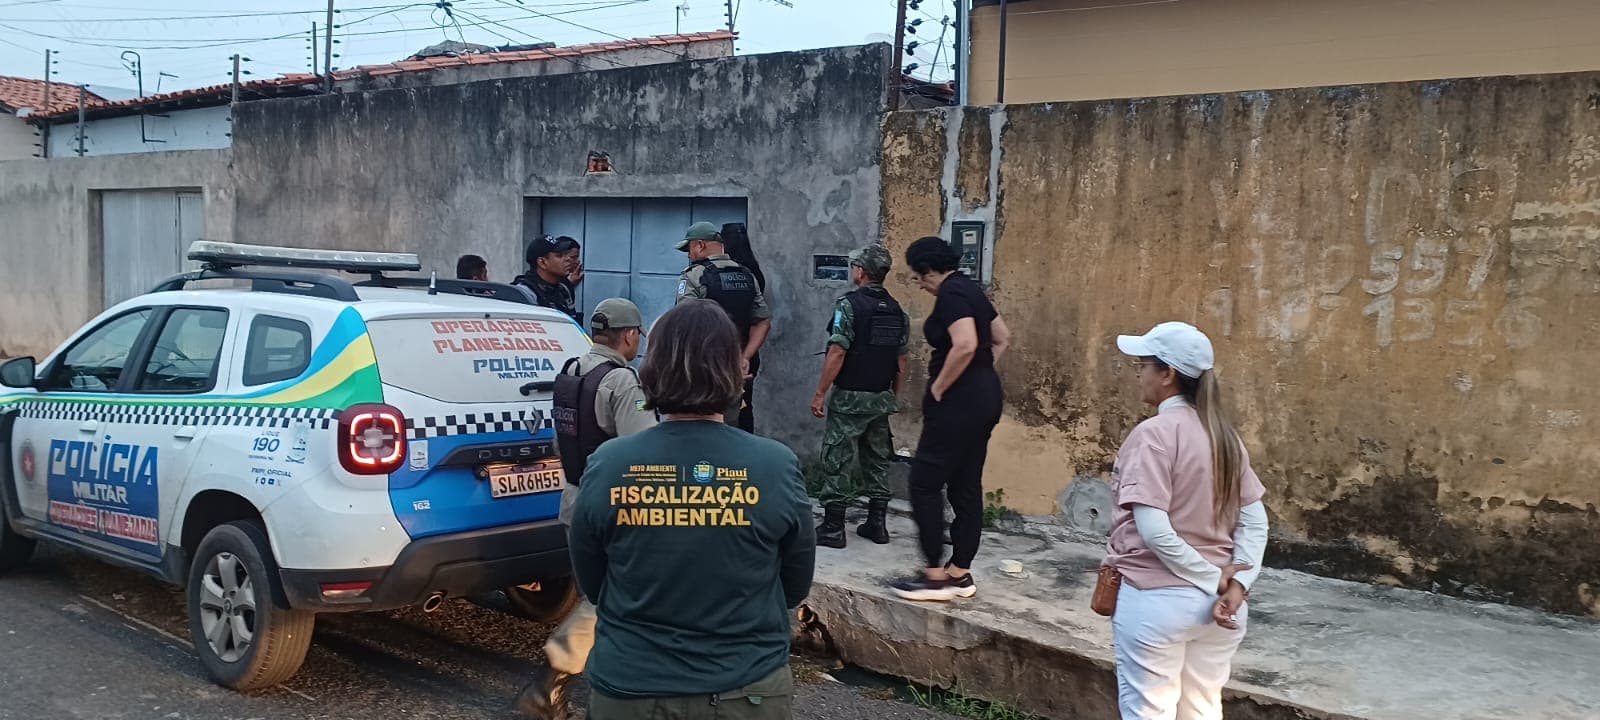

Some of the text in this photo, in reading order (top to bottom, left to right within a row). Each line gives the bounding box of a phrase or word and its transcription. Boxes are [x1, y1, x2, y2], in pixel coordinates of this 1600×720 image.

[431, 319, 547, 335] OPERAÇÕES
[433, 338, 564, 353] PLANEJADAS
[473, 356, 555, 373] POLÍCIA
[498, 372, 538, 380] MILITAR
[253, 437, 280, 452] 190
[49, 434, 158, 486] POLÍCIA
[646, 464, 677, 472] AMBIENTE
[716, 467, 747, 477] Piauí
[498, 471, 560, 493] SLR6H55
[72, 481, 128, 505] MILITAR
[610, 482, 759, 508] FISCALIZAÇÃO
[413, 500, 431, 510] 162
[616, 508, 751, 526] AMBIENTAL
